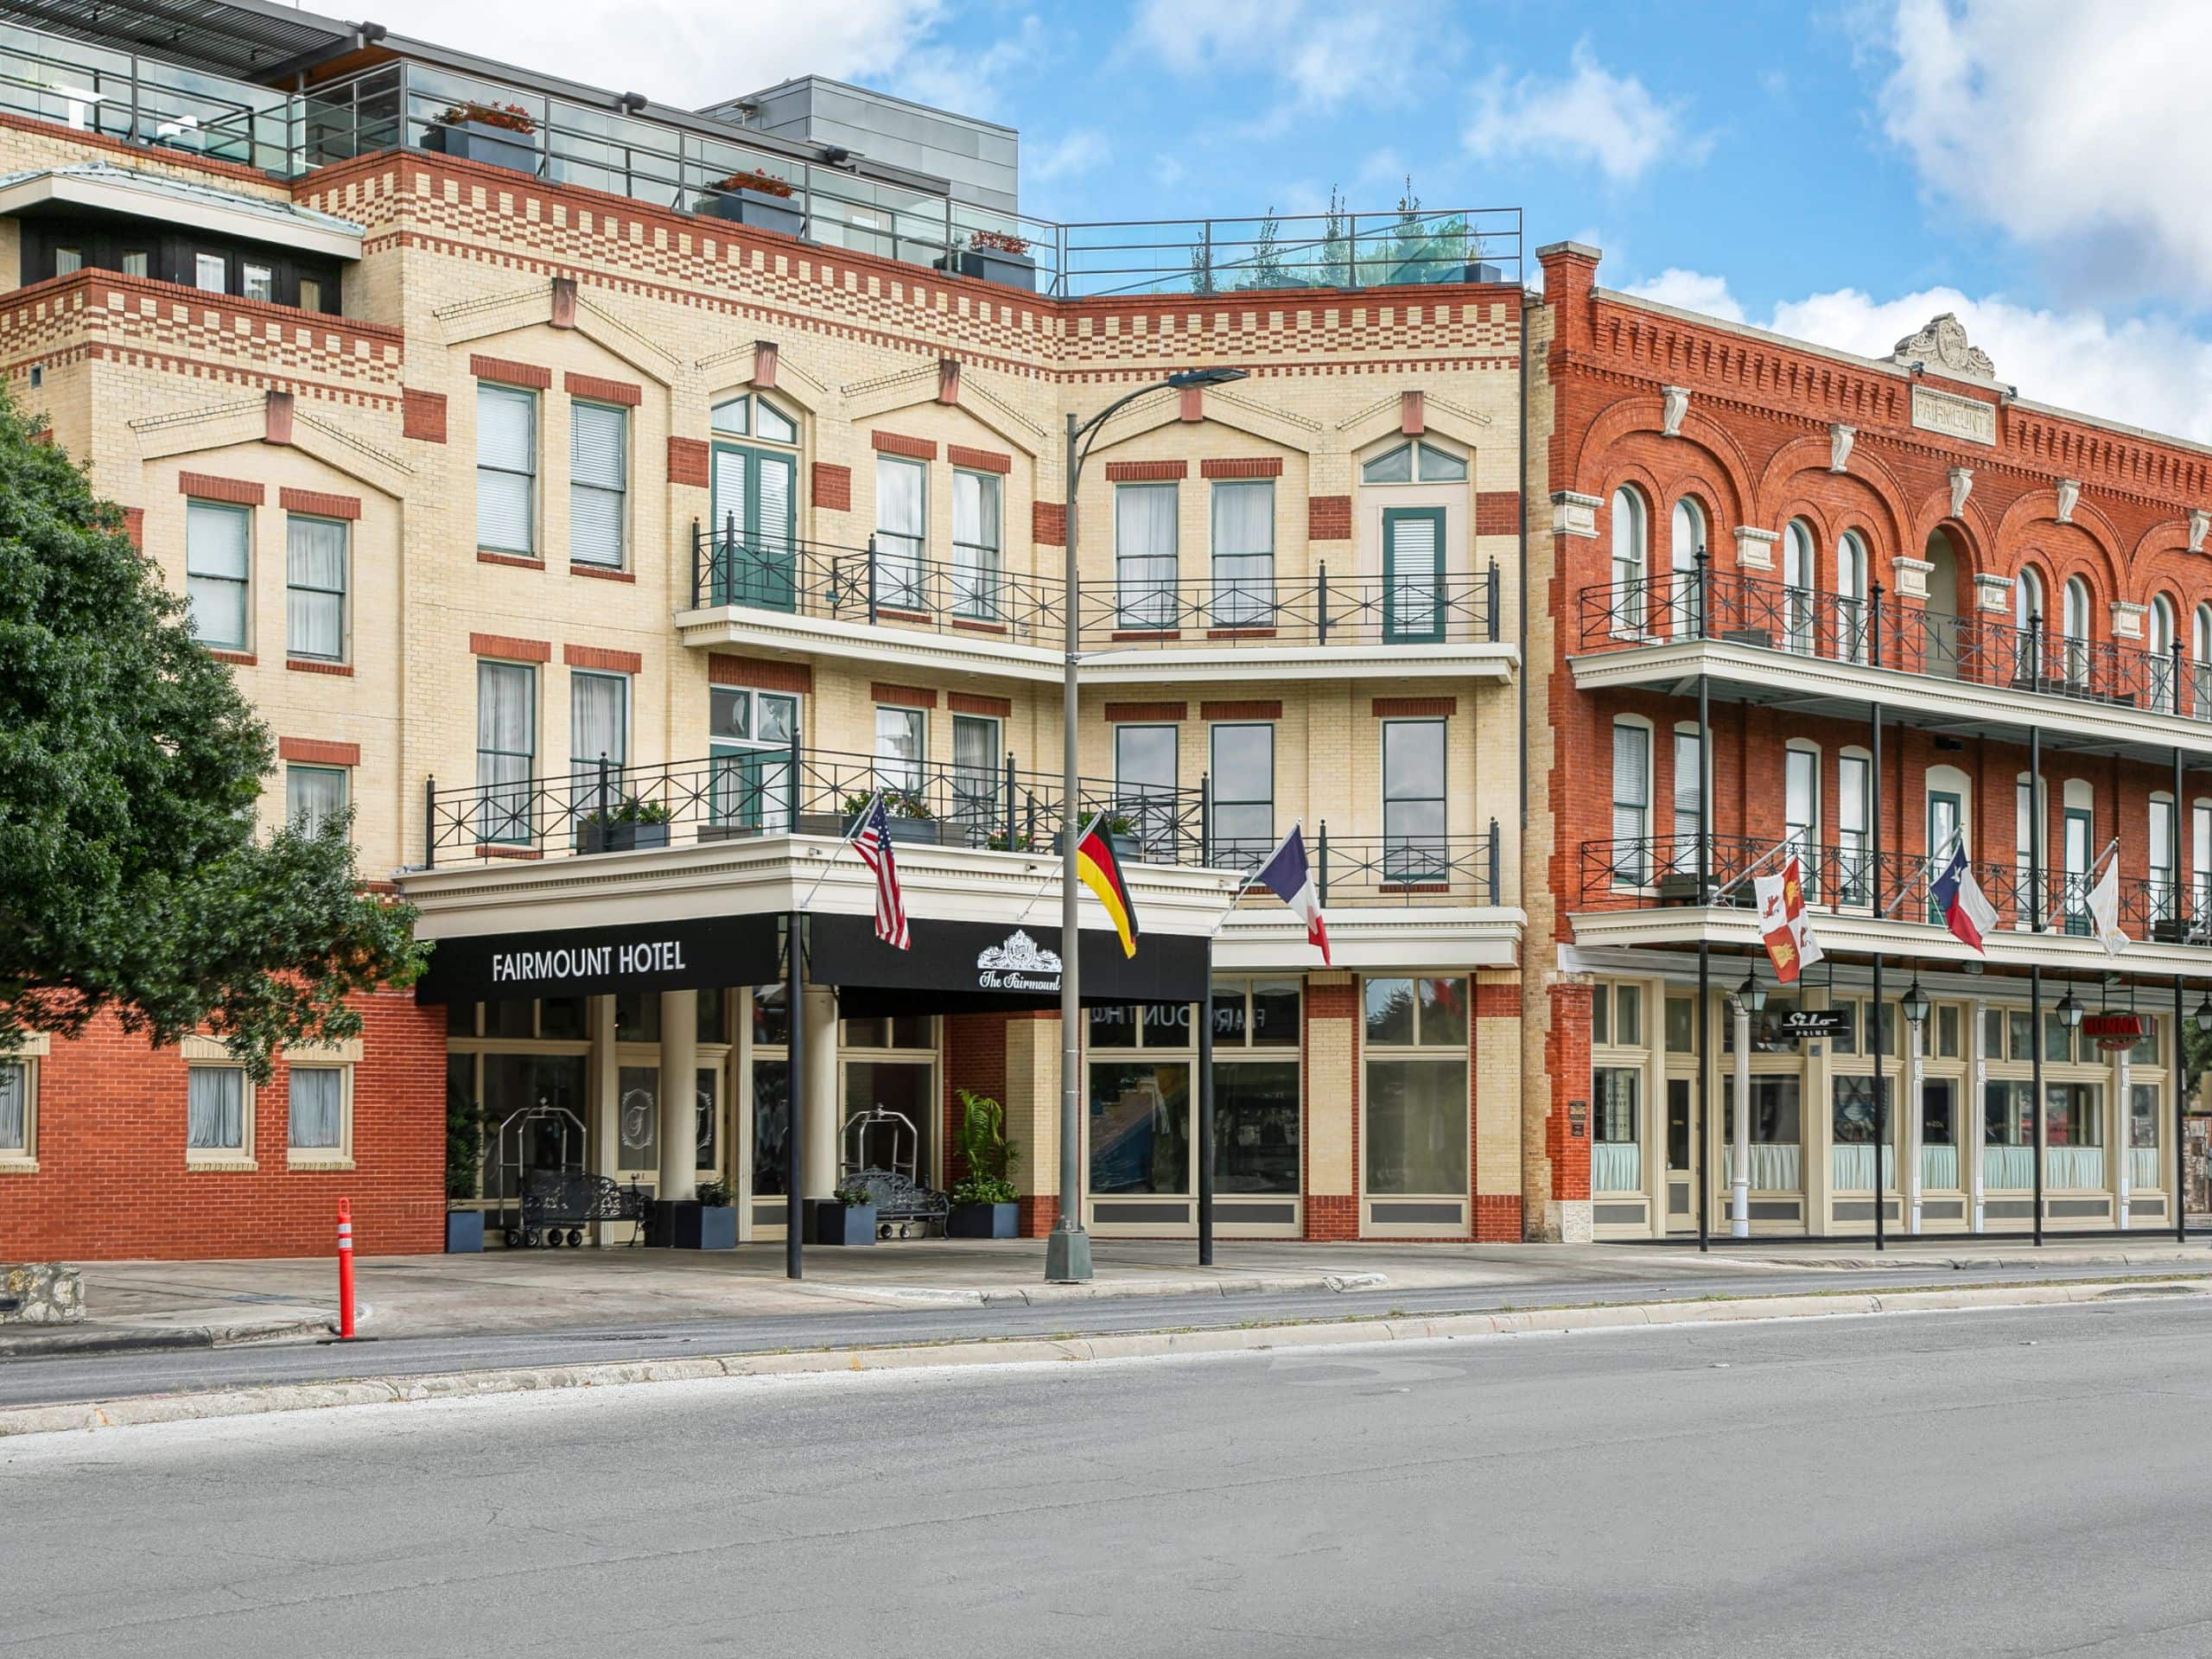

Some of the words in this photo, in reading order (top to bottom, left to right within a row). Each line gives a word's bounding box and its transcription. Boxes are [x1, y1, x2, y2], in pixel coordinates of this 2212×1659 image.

[493, 946, 612, 982] FAIRMOUNT
[619, 941, 686, 974] HOTEL
[979, 970, 1002, 988] The
[1003, 972, 1061, 991] Fairmount
